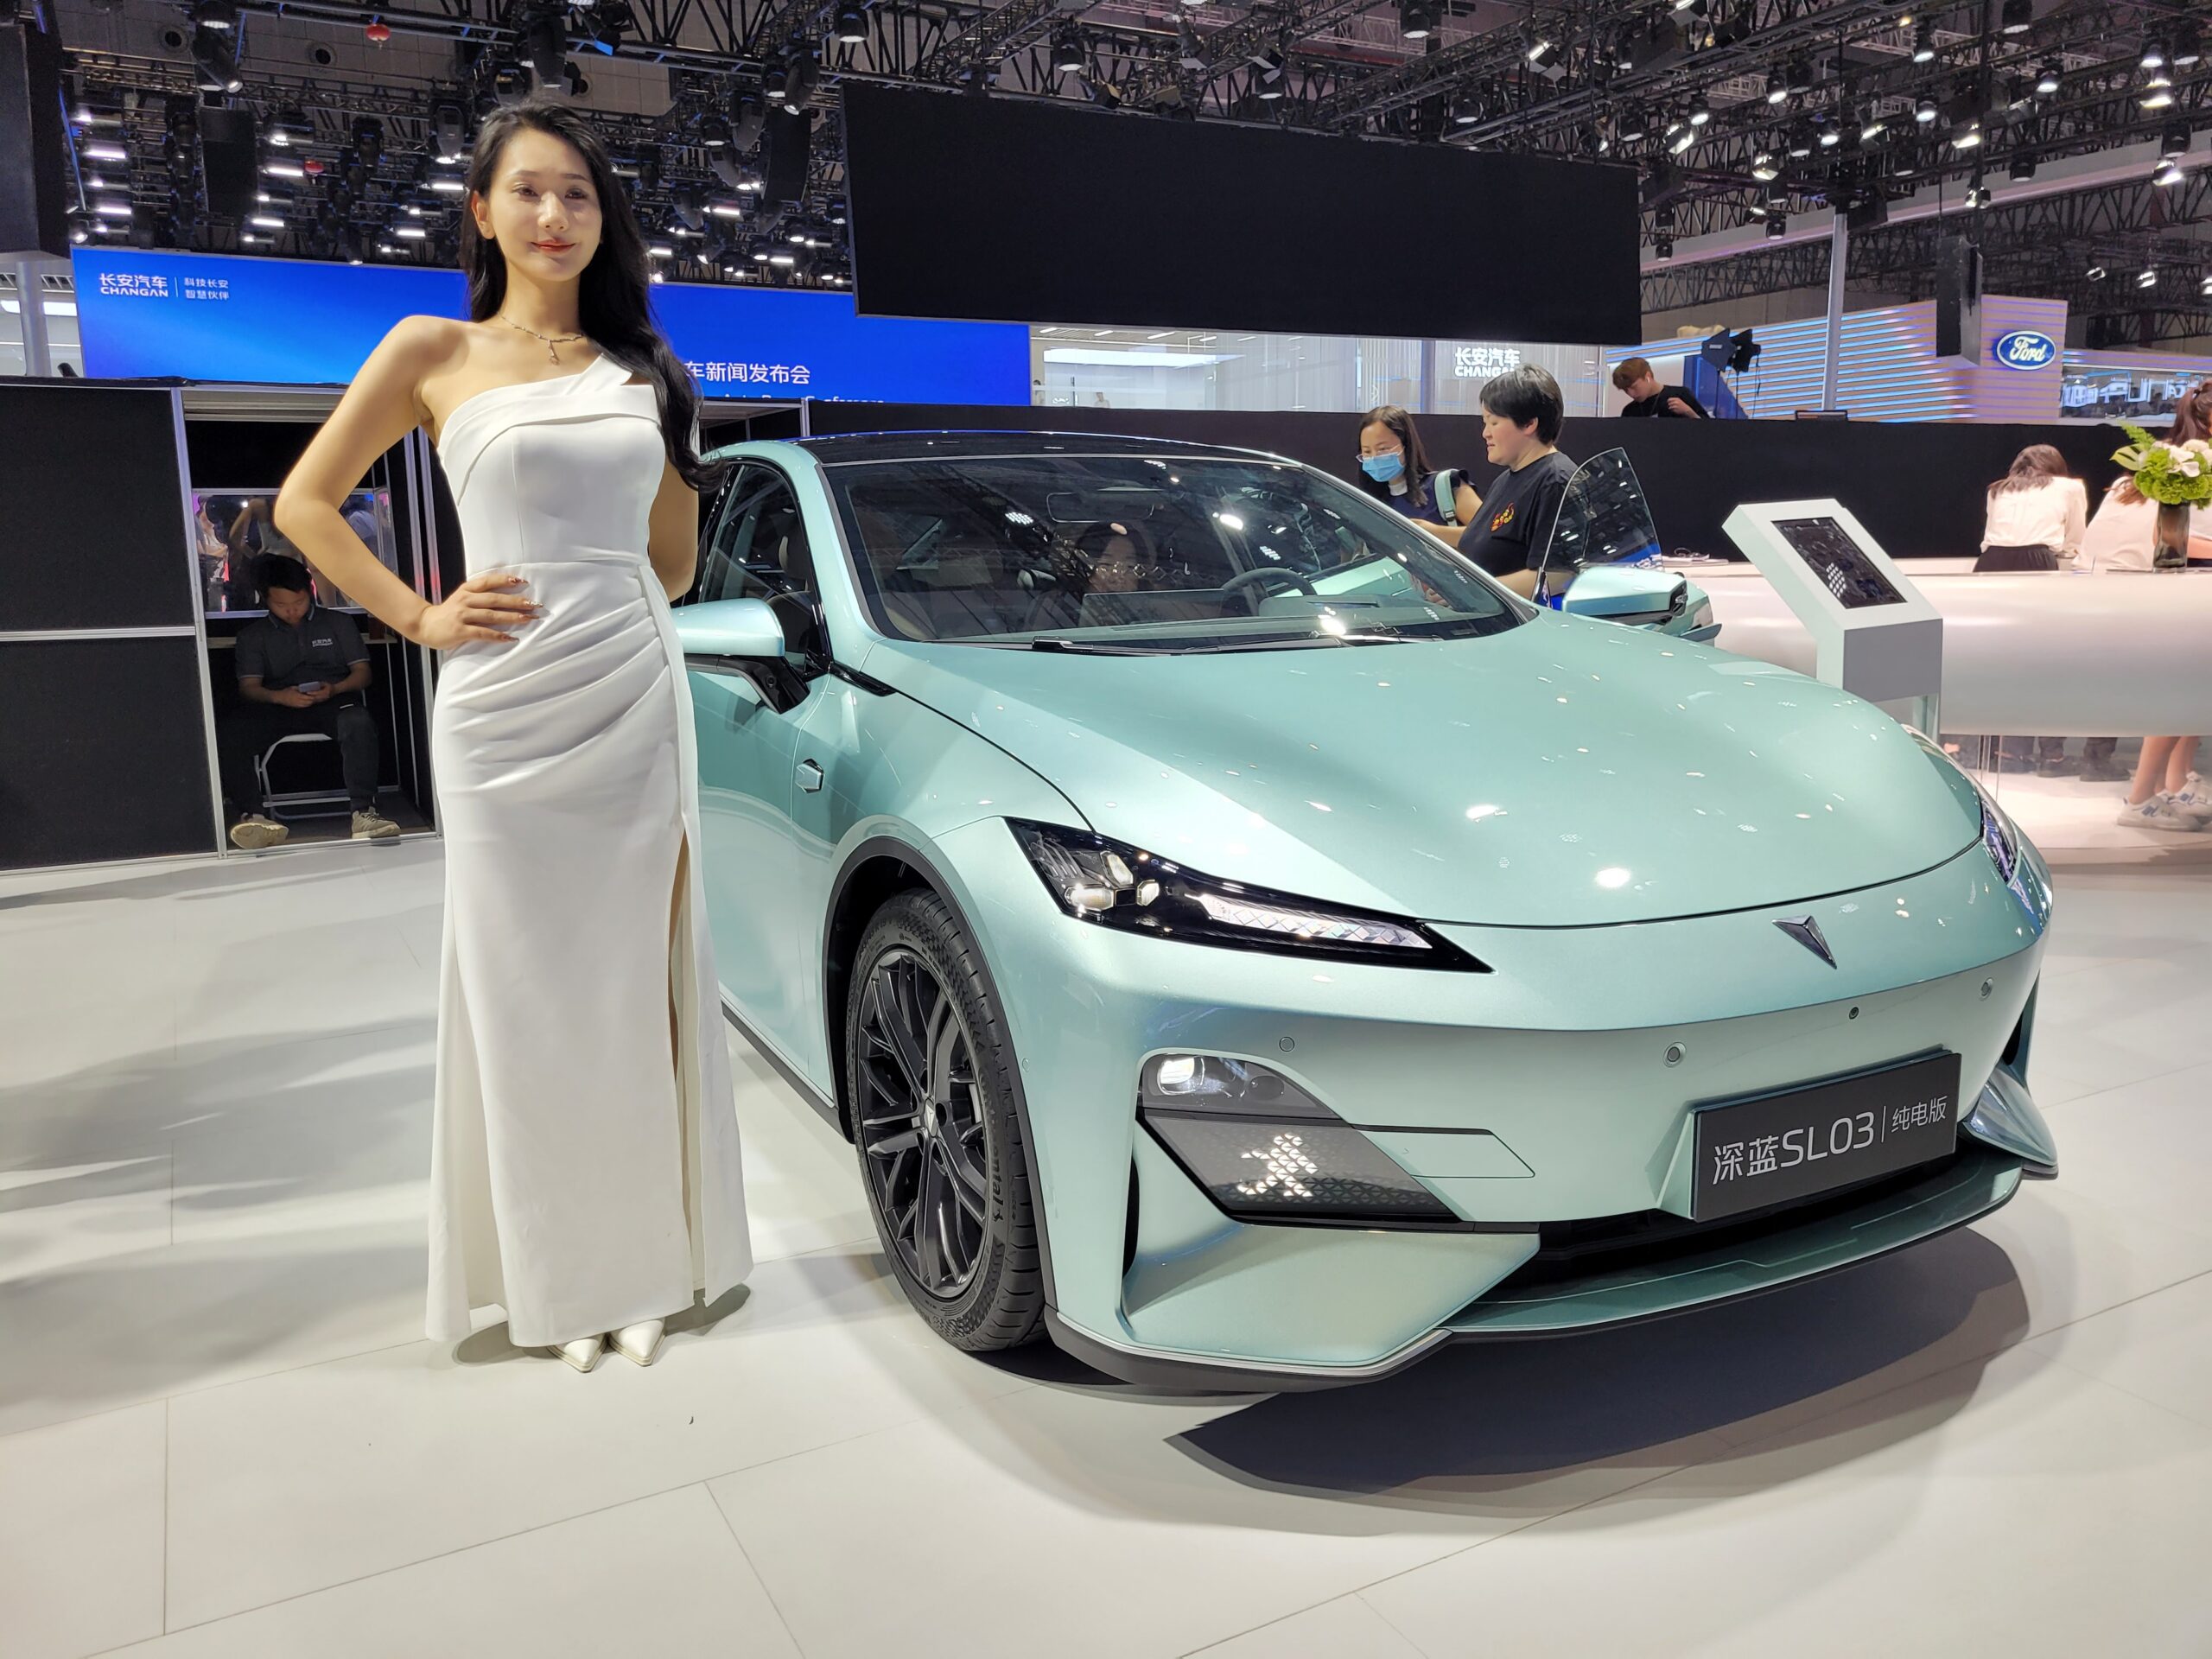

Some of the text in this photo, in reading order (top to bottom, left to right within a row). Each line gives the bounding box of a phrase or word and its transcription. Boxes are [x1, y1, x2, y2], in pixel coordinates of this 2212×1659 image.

[99, 273, 168, 288] 长安汽车
[184, 277, 229, 289] 科技长安
[100, 286, 168, 297] CHANGAN
[185, 289, 229, 301] 智慧伙伴
[2009, 336, 2048, 361] Ford
[1455, 347, 1521, 367] 长安汽车
[684, 361, 810, 385] 车新闻发布会
[1455, 365, 1515, 378] CHANGA
[1713, 1096, 1948, 1185] 深蓝SL03 纯电版
